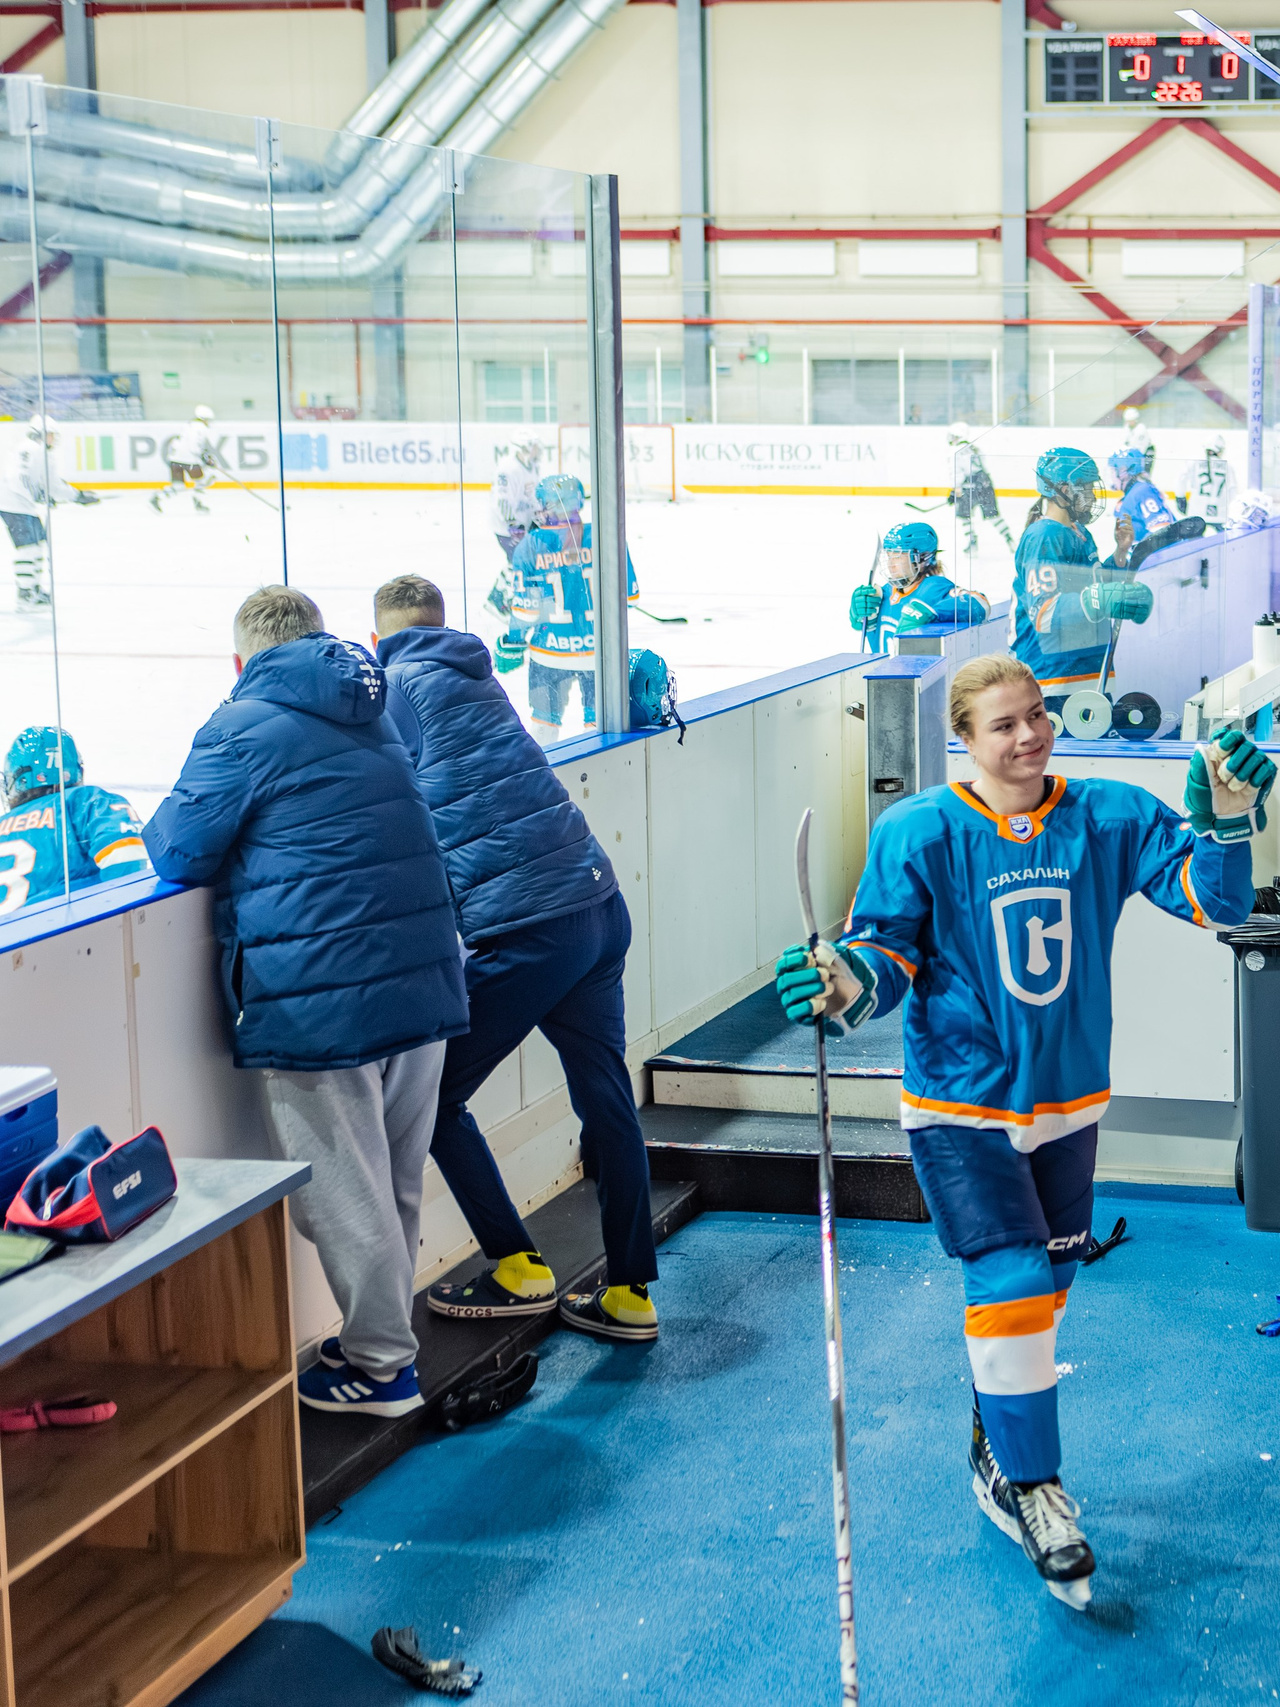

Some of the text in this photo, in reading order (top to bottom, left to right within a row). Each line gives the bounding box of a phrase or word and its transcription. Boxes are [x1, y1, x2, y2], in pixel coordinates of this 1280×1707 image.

[1134, 54, 1151, 81] 0
[1176, 55, 1185, 75] 1
[1221, 52, 1239, 80] 0
[1251, 356, 1262, 458] СПОРТМАКС
[342, 440, 466, 464] Bilet65.ru
[821, 443, 877, 462] ТЕЛА
[1198, 471, 1226, 498] 27
[1140, 498, 1160, 519] 18
[1026, 565, 1058, 598] 49
[986, 867, 1071, 890] САХАЛИН
[112, 1169, 142, 1200] EFSI
[447, 1306, 493, 1318] crocs
